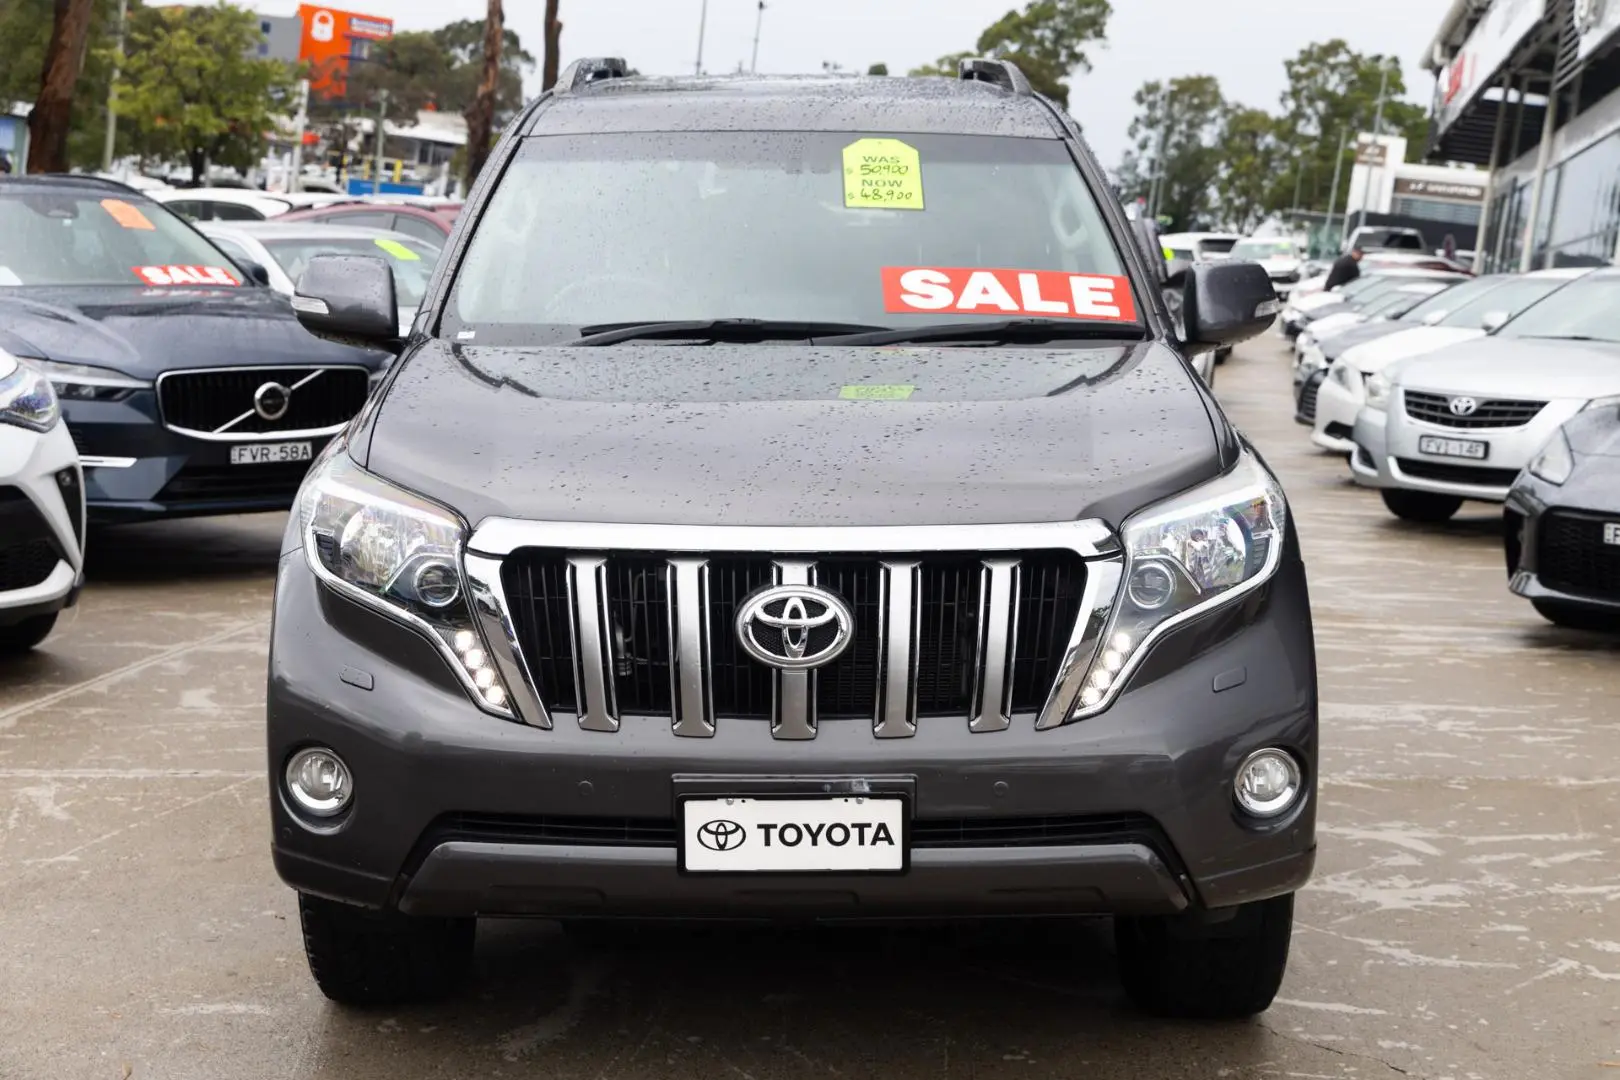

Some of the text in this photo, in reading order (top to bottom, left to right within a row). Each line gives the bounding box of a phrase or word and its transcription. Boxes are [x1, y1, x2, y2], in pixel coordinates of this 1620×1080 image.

[862, 179, 902, 188] NOW
[141, 266, 236, 285] SALE
[900, 270, 1121, 317] SALE
[757, 822, 895, 847] TOYOTA
